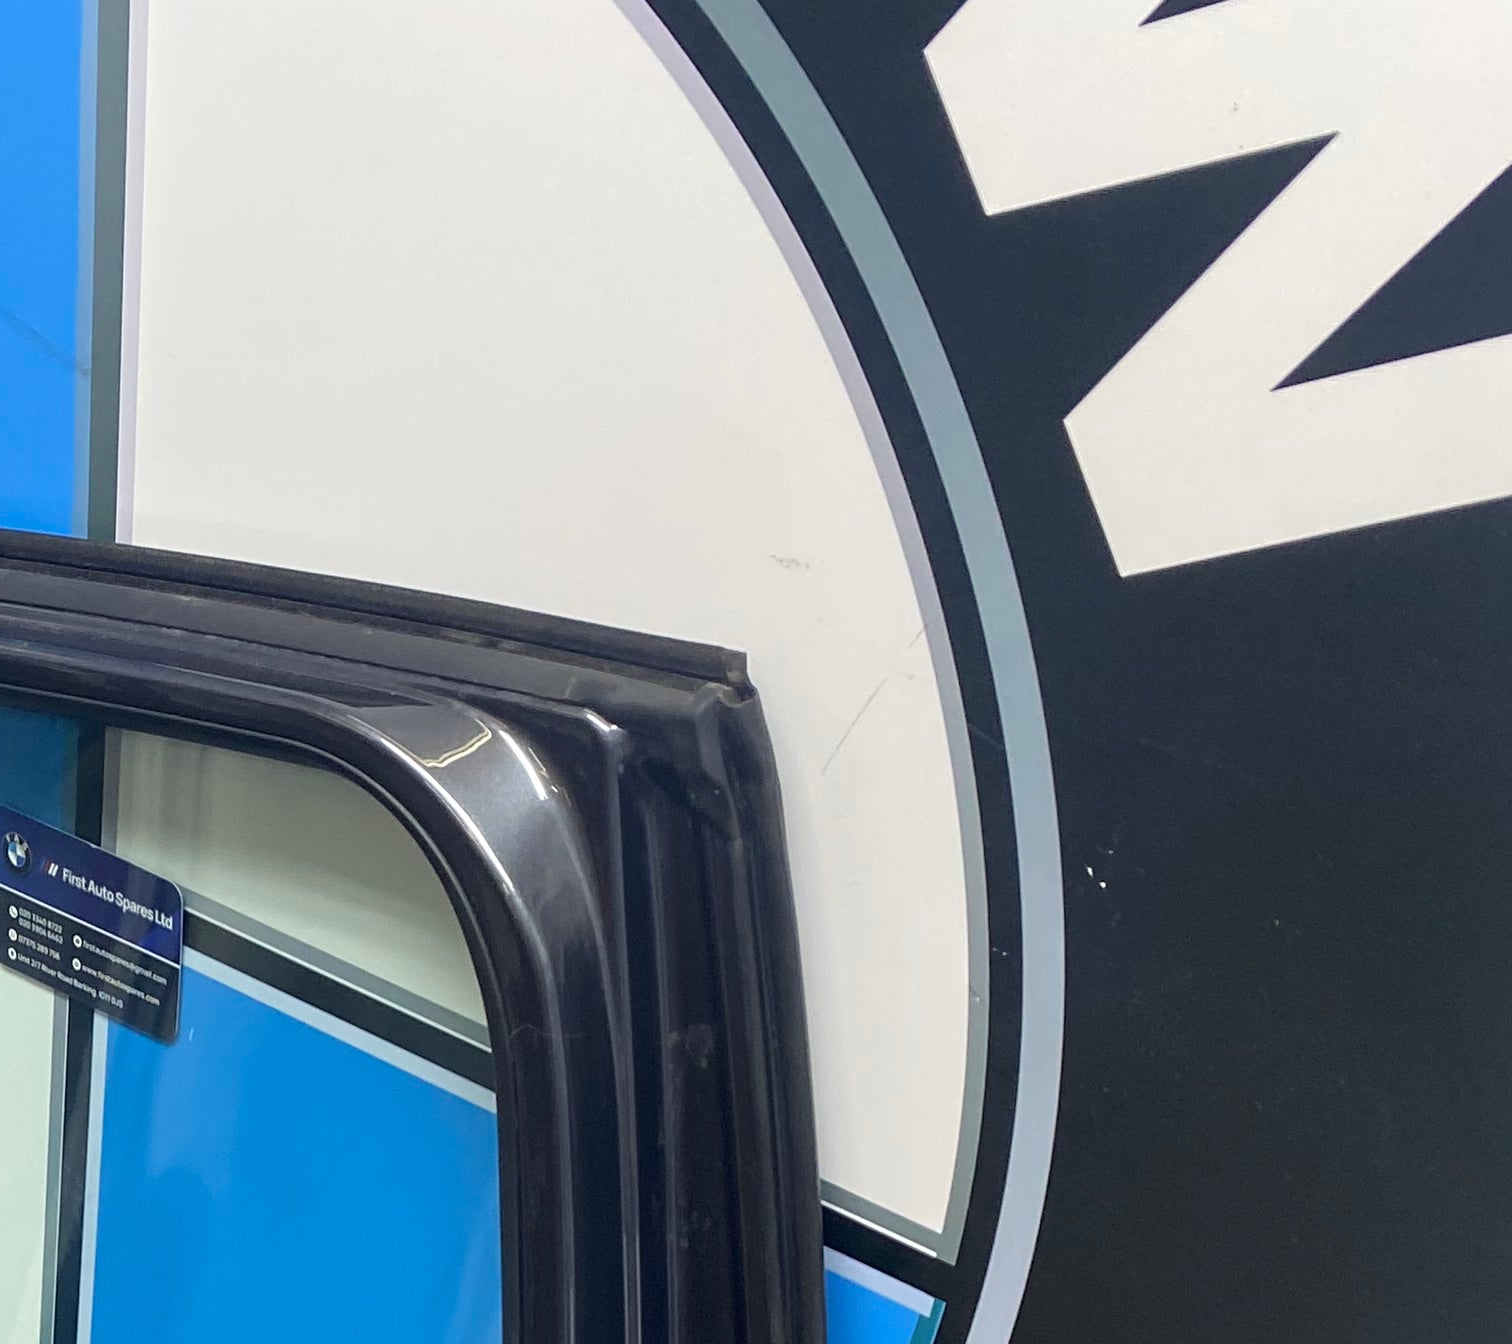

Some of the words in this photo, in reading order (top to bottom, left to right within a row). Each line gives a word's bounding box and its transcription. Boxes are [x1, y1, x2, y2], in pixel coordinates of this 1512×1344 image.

[62, 867, 87, 891] First
[88, 881, 114, 903] Auto
[115, 892, 155, 923] Spares
[155, 910, 173, 930] Ltd
